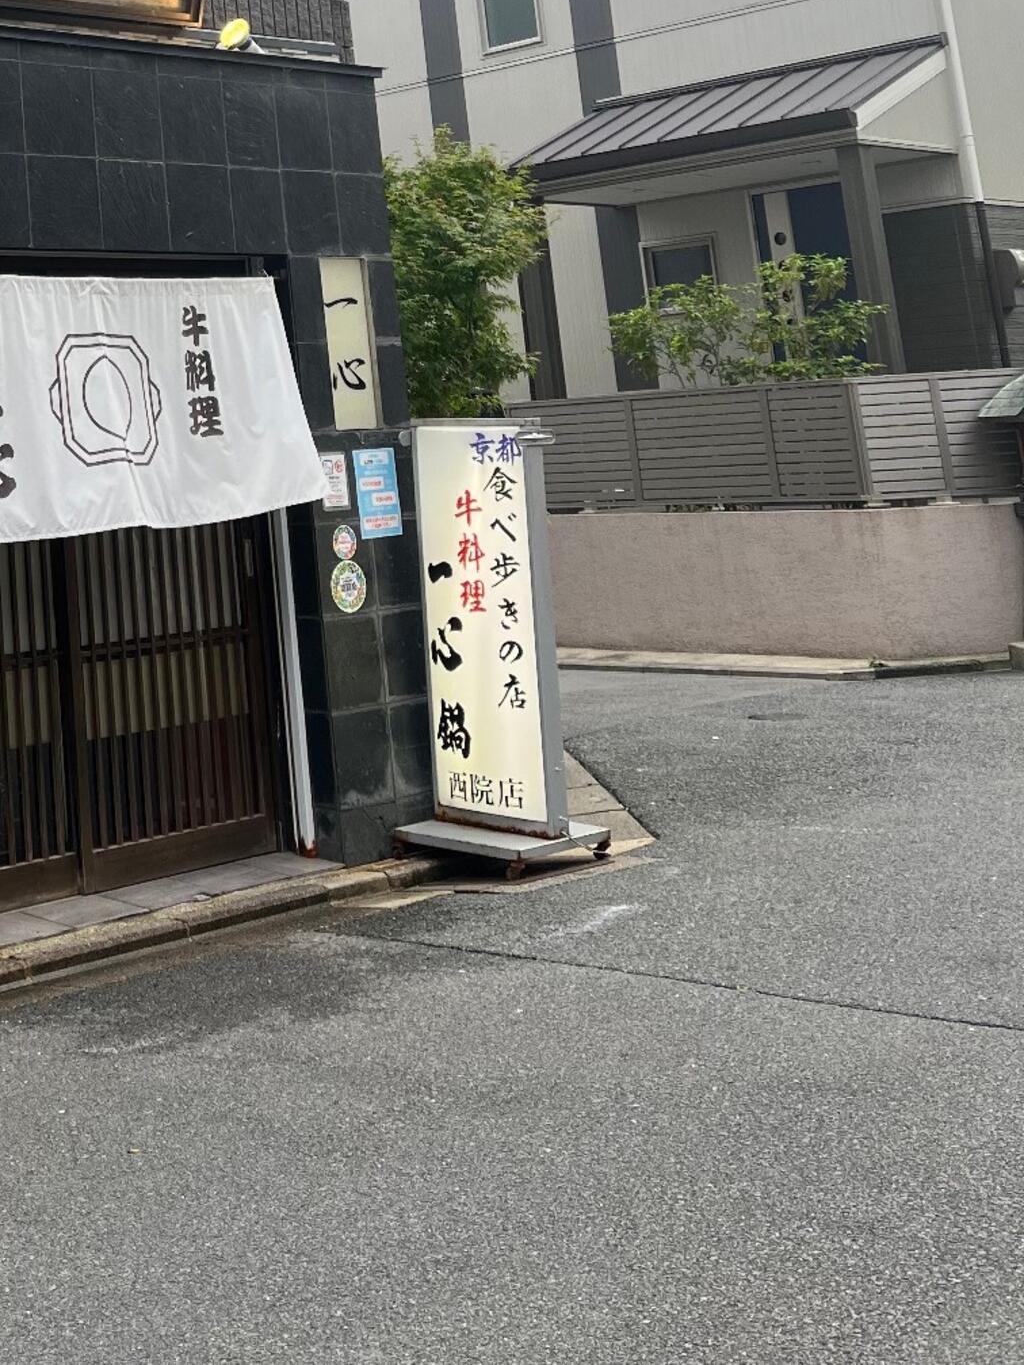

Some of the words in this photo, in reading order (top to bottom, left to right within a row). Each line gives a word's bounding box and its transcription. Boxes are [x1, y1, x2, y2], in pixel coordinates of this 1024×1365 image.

[181, 305, 225, 438] 牛料理
[323, 296, 367, 391] 一心
[469, 433, 523, 466] 京都
[455, 490, 487, 614] 牛料理
[482, 466, 528, 710] 食べ歩きの店
[428, 560, 472, 760] 一心鍋
[448, 770, 524, 810] 西院店
